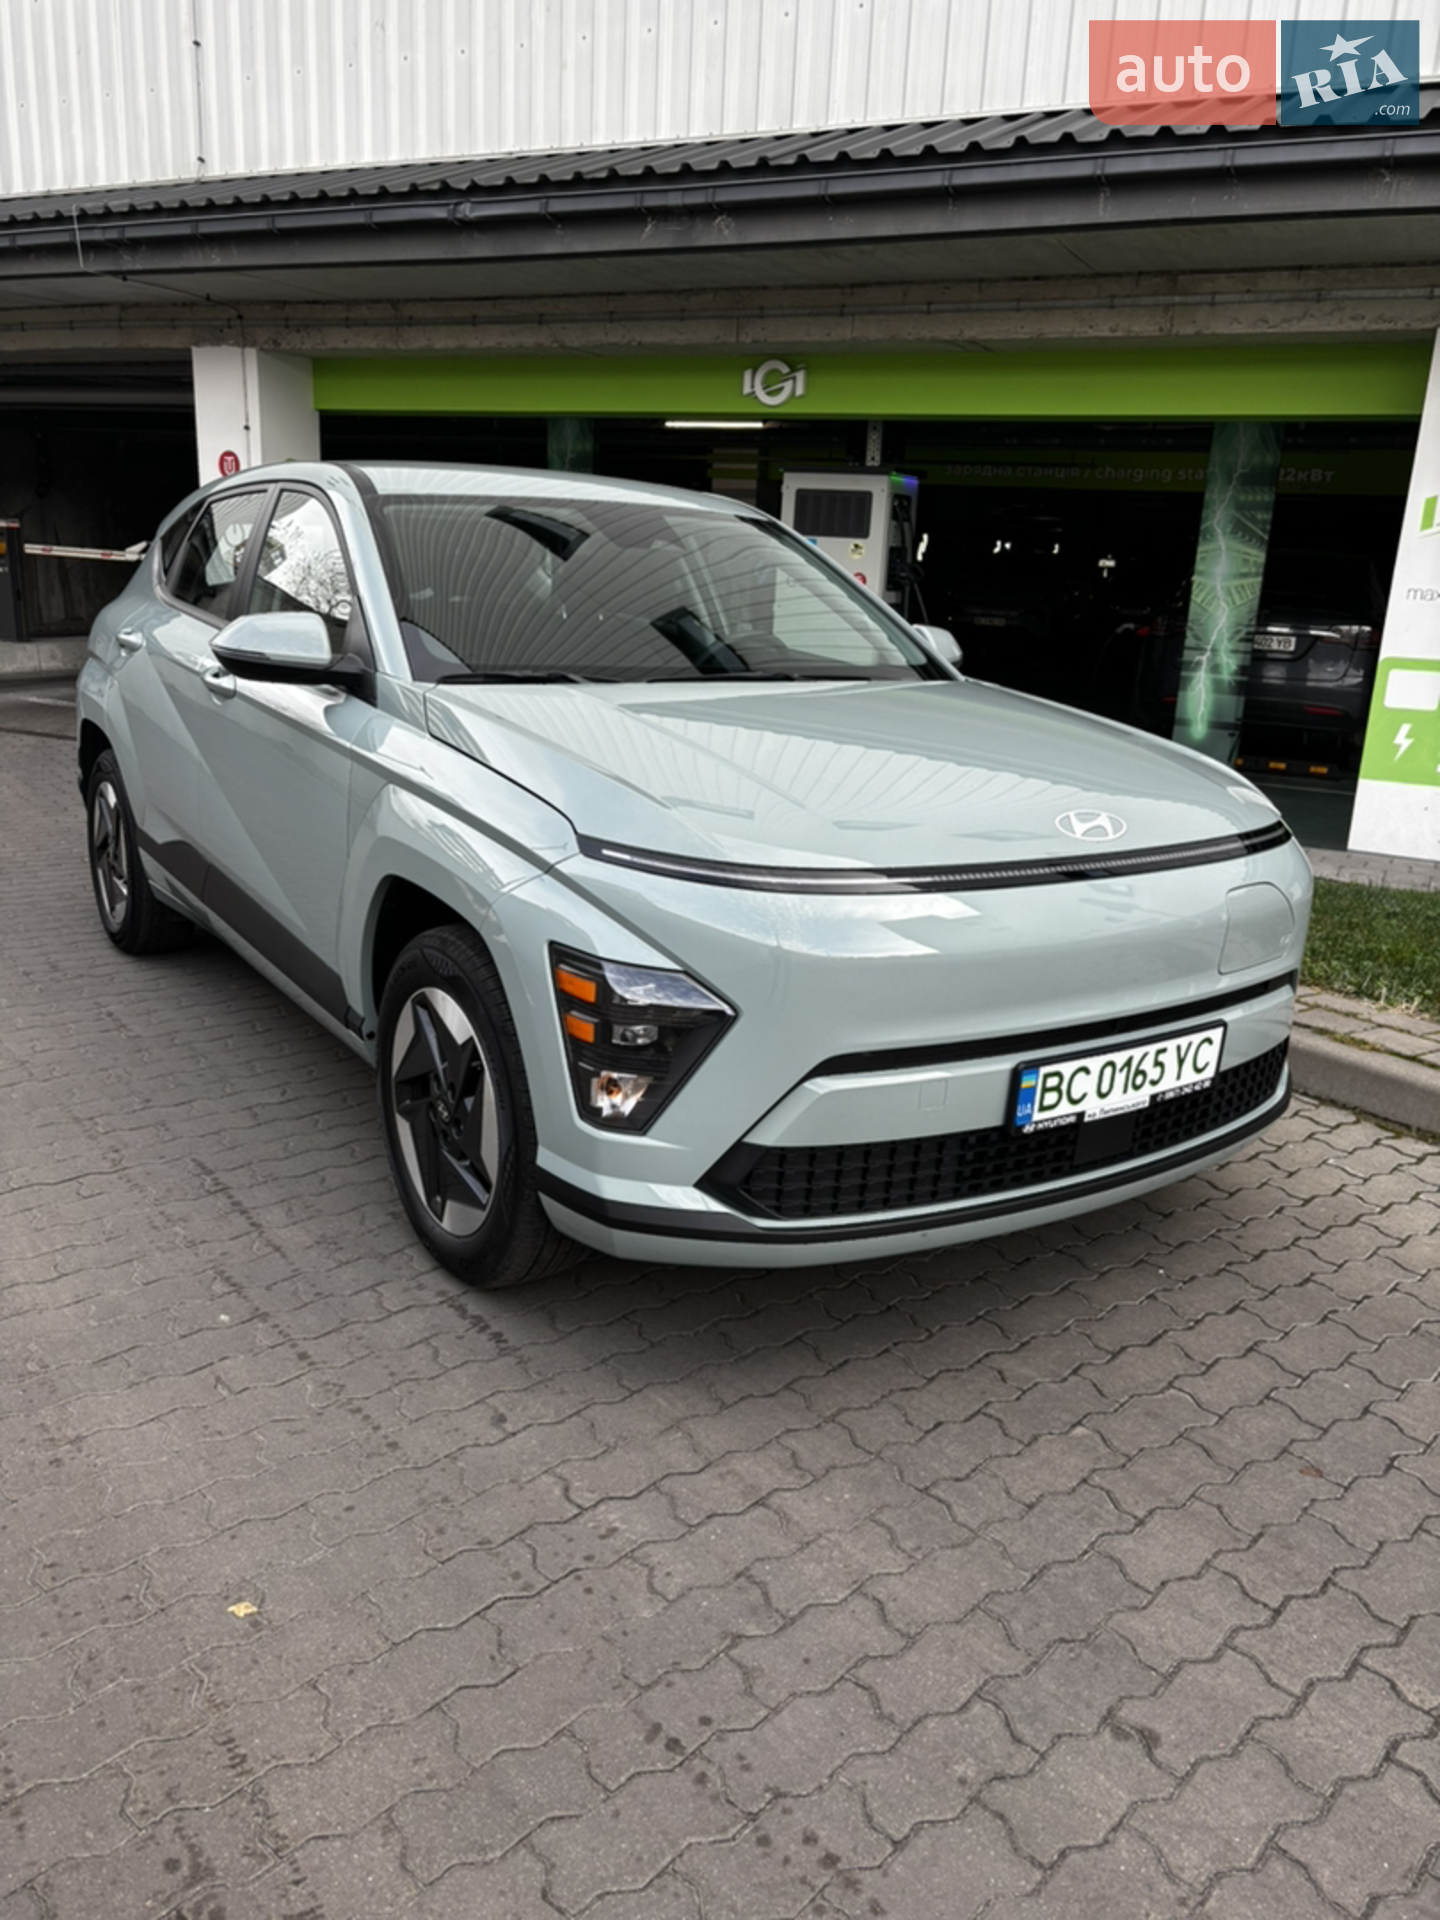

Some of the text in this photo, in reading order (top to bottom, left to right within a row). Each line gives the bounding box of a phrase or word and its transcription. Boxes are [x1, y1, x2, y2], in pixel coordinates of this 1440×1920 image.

[945, 464, 1012, 477] зарядна
[1016, 465, 1079, 479] станція
[1095, 467, 1172, 483] charging
[1178, 468, 1204, 480] sta
[1037, 1065, 1091, 1113] BC
[1096, 1047, 1168, 1100] 0165
[1175, 1036, 1214, 1081] YC
[1016, 1103, 1032, 1117] UA
